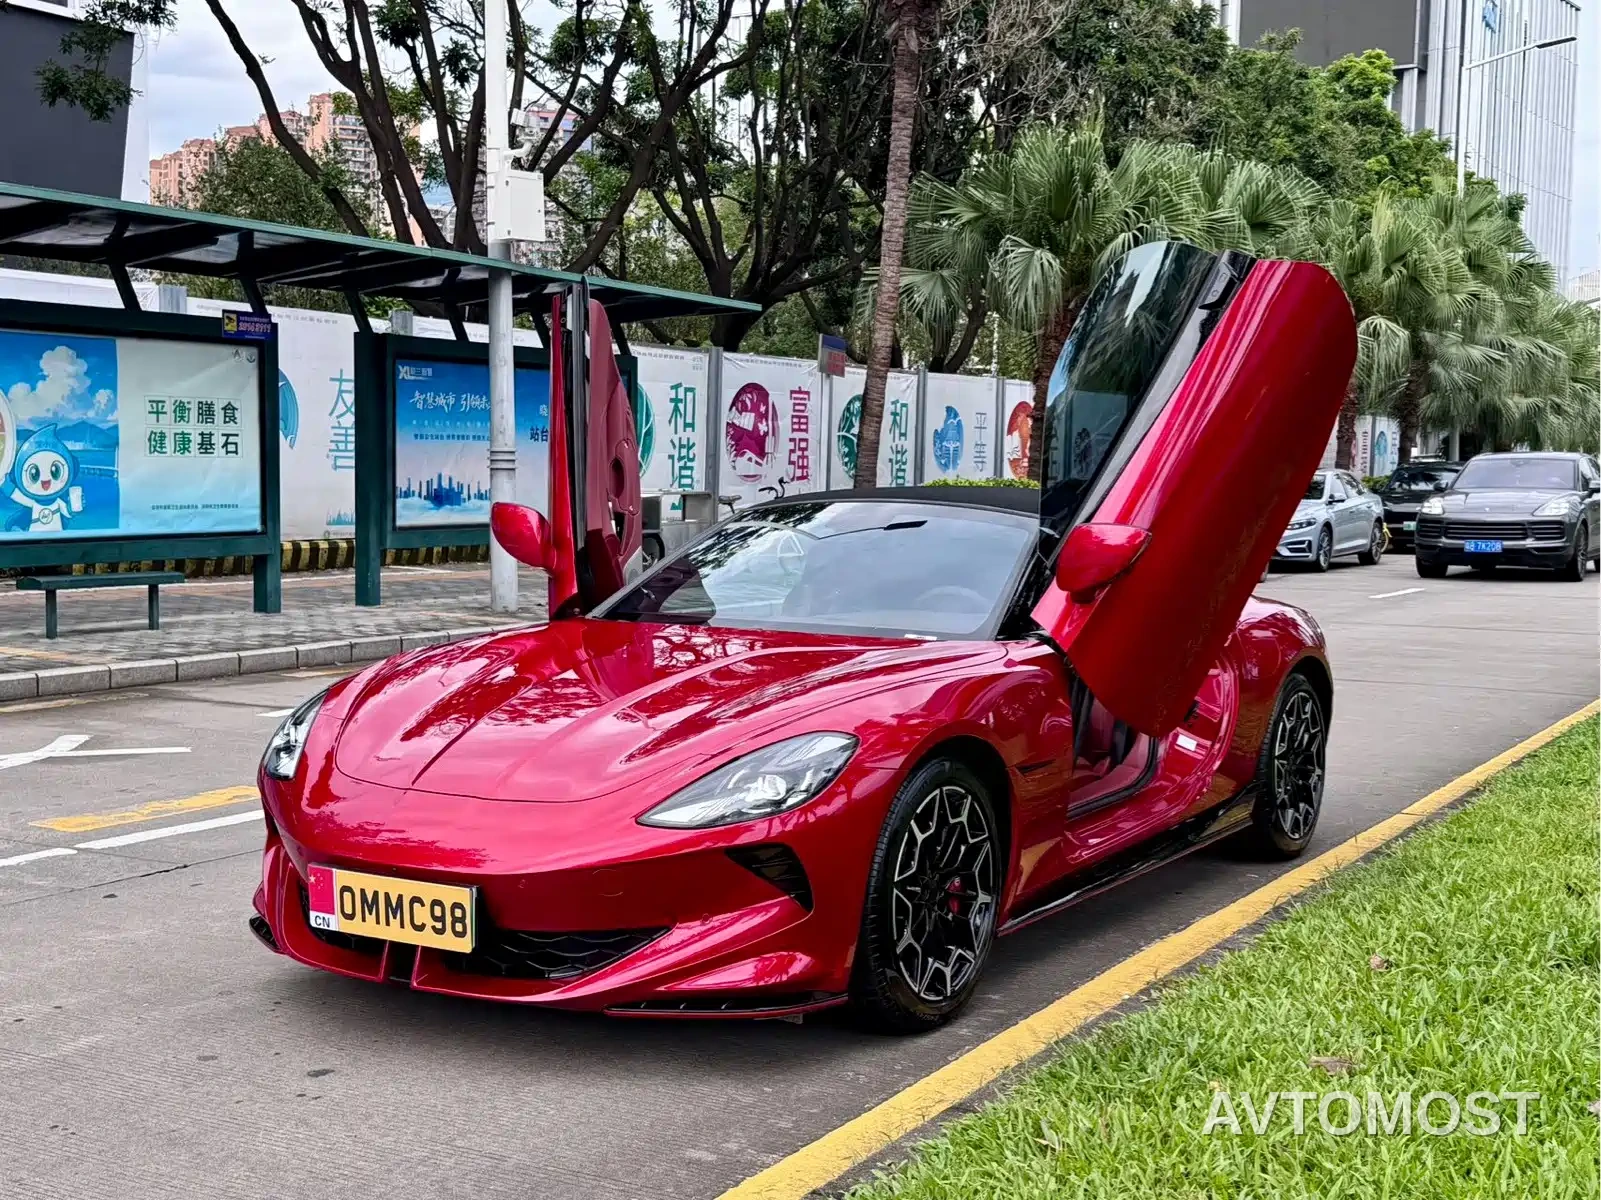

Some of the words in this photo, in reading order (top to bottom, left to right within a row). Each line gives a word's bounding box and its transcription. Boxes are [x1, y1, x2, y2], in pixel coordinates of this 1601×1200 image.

[148, 399, 239, 424] 平衡膳食
[409, 390, 457, 413] 智慧城市
[148, 430, 239, 455] 健康基石
[668, 382, 696, 490] 和谐
[788, 386, 811, 481] 富强
[889, 399, 909, 485] 和谐
[974, 412, 987, 472] 平等
[314, 915, 331, 928] CN
